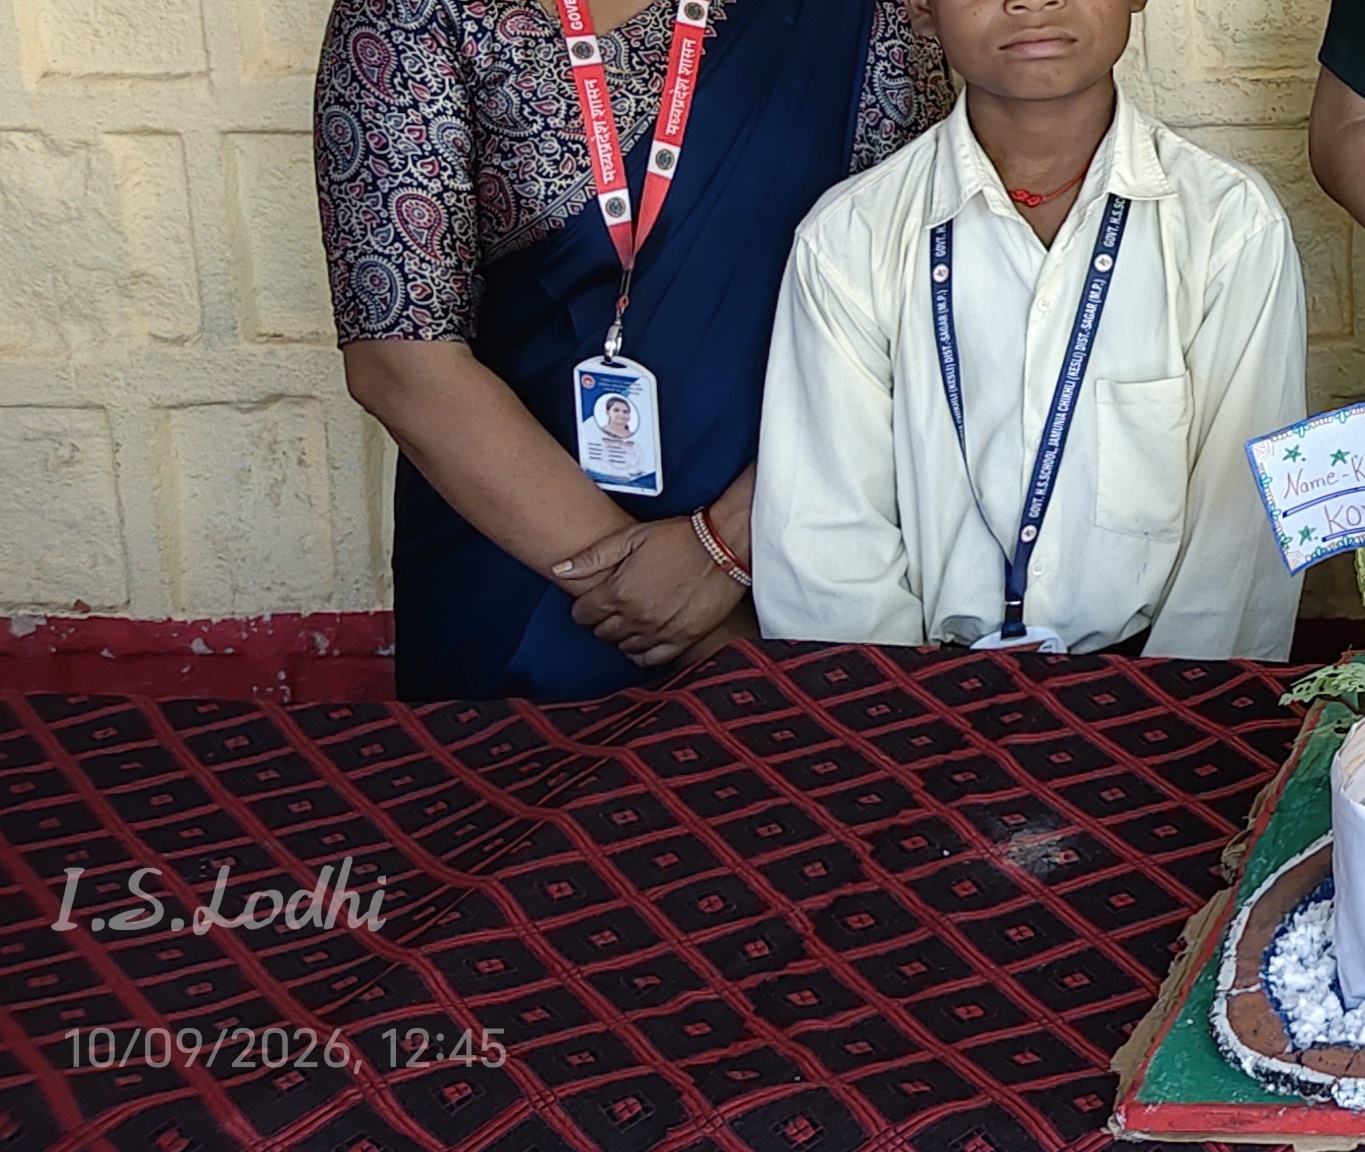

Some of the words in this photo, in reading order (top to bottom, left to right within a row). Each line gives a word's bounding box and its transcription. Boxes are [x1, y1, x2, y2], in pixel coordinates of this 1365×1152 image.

[677, 37, 697, 76] शासन
[584, 79, 606, 119] शासन
[1103, 226, 1119, 248] GOVT.
[1057, 381, 1076, 412] CHIKHLI
[1048, 412, 1067, 447] JAMUNIA
[1028, 495, 1045, 518] GOVT.
